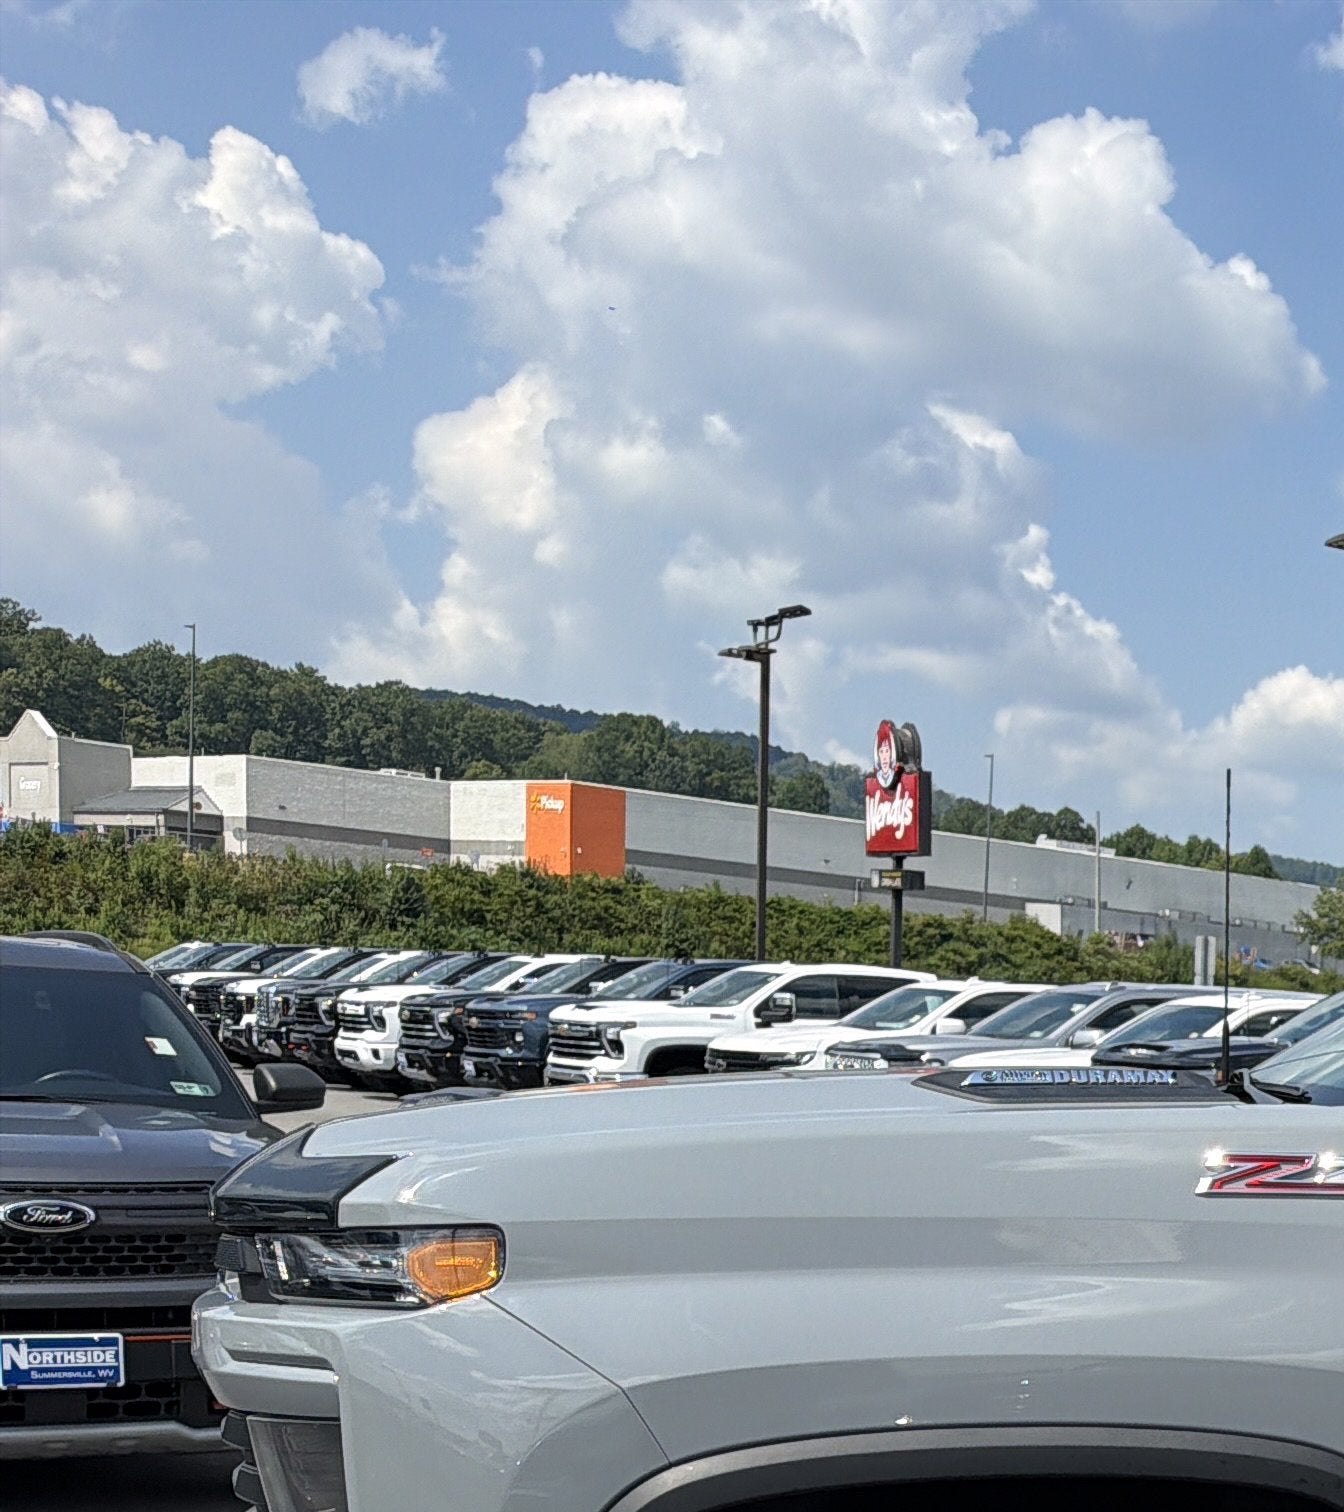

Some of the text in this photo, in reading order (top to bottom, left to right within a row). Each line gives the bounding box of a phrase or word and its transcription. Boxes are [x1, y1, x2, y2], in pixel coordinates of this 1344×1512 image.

[865, 782, 914, 841] Wendy's
[2, 1342, 117, 1371] NORTHSIDE
[97, 1368, 115, 1378] WV
